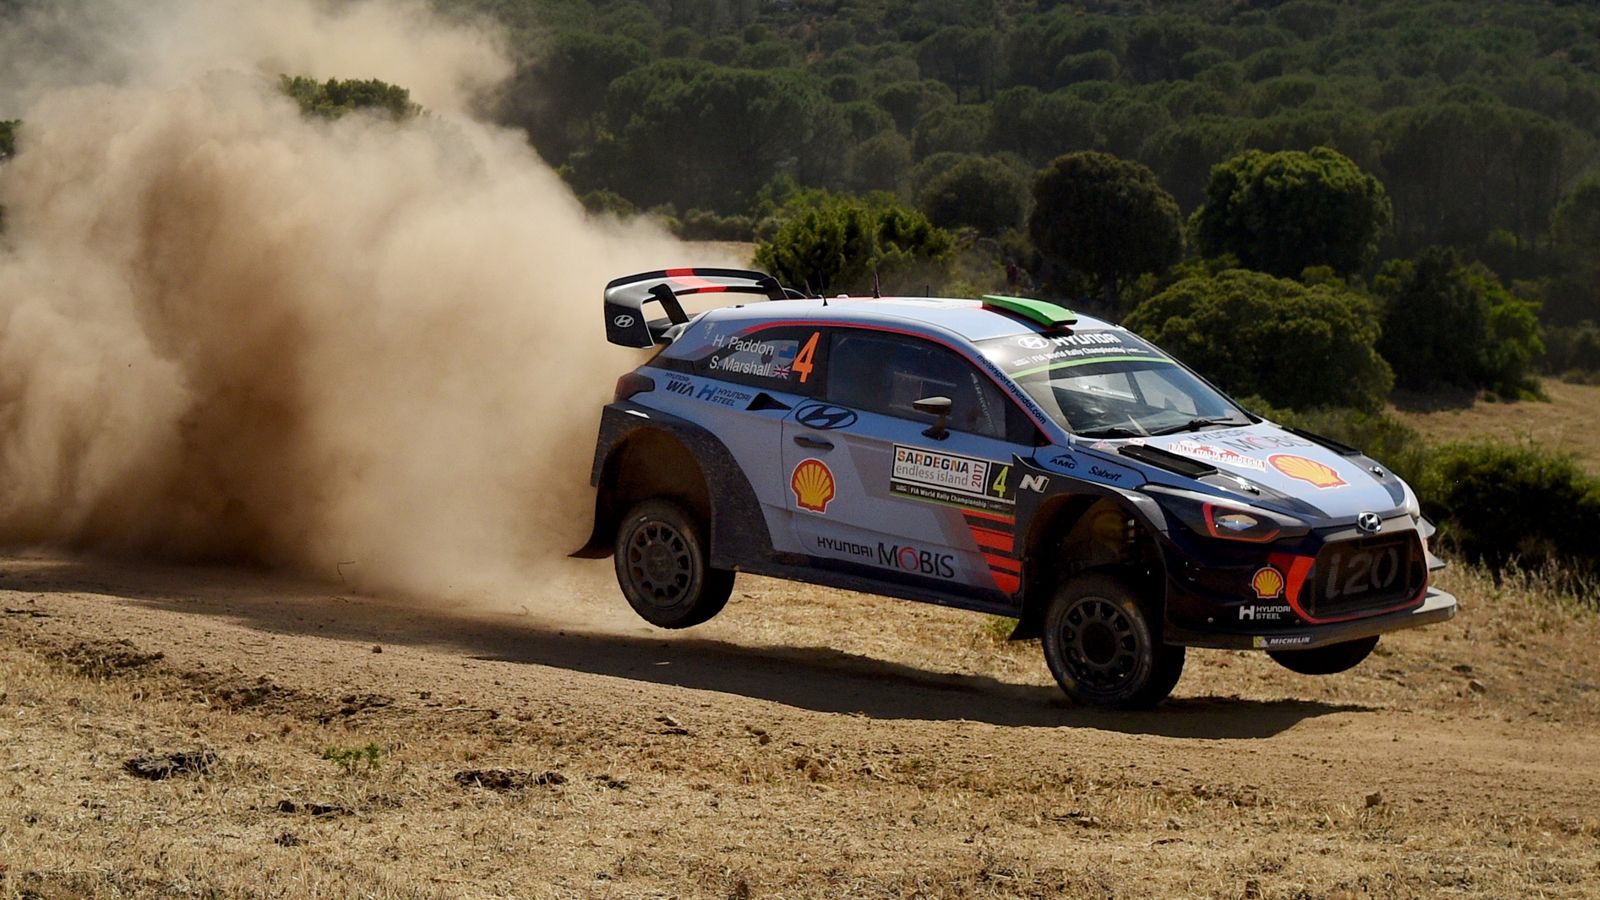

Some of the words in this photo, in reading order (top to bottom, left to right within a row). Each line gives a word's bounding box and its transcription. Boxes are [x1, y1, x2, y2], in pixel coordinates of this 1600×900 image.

[712, 334, 725, 348] H.
[727, 336, 775, 356] Paddon
[709, 355, 720, 370] S.
[722, 357, 771, 377] Marshall
[791, 331, 821, 384] 4
[713, 395, 736, 407] STEEL
[718, 388, 753, 402] HYUNDAI
[976, 354, 1047, 426] motorsport.hyundai.com
[897, 449, 969, 474] SARDEGNA
[896, 463, 935, 481] endless
[937, 469, 969, 486] island
[971, 463, 984, 488] 2017
[992, 465, 1009, 498] 4
[910, 487, 920, 495] FIA
[920, 489, 936, 498] World
[936, 492, 950, 501] Rally
[950, 494, 987, 508] Championship
[817, 536, 873, 558] HYUNDAI
[878, 542, 955, 578] MOBIS
[1255, 605, 1291, 613] HYUNDAI
[1255, 612, 1281, 620] STEEL
[1269, 636, 1311, 645] MICHELIN
